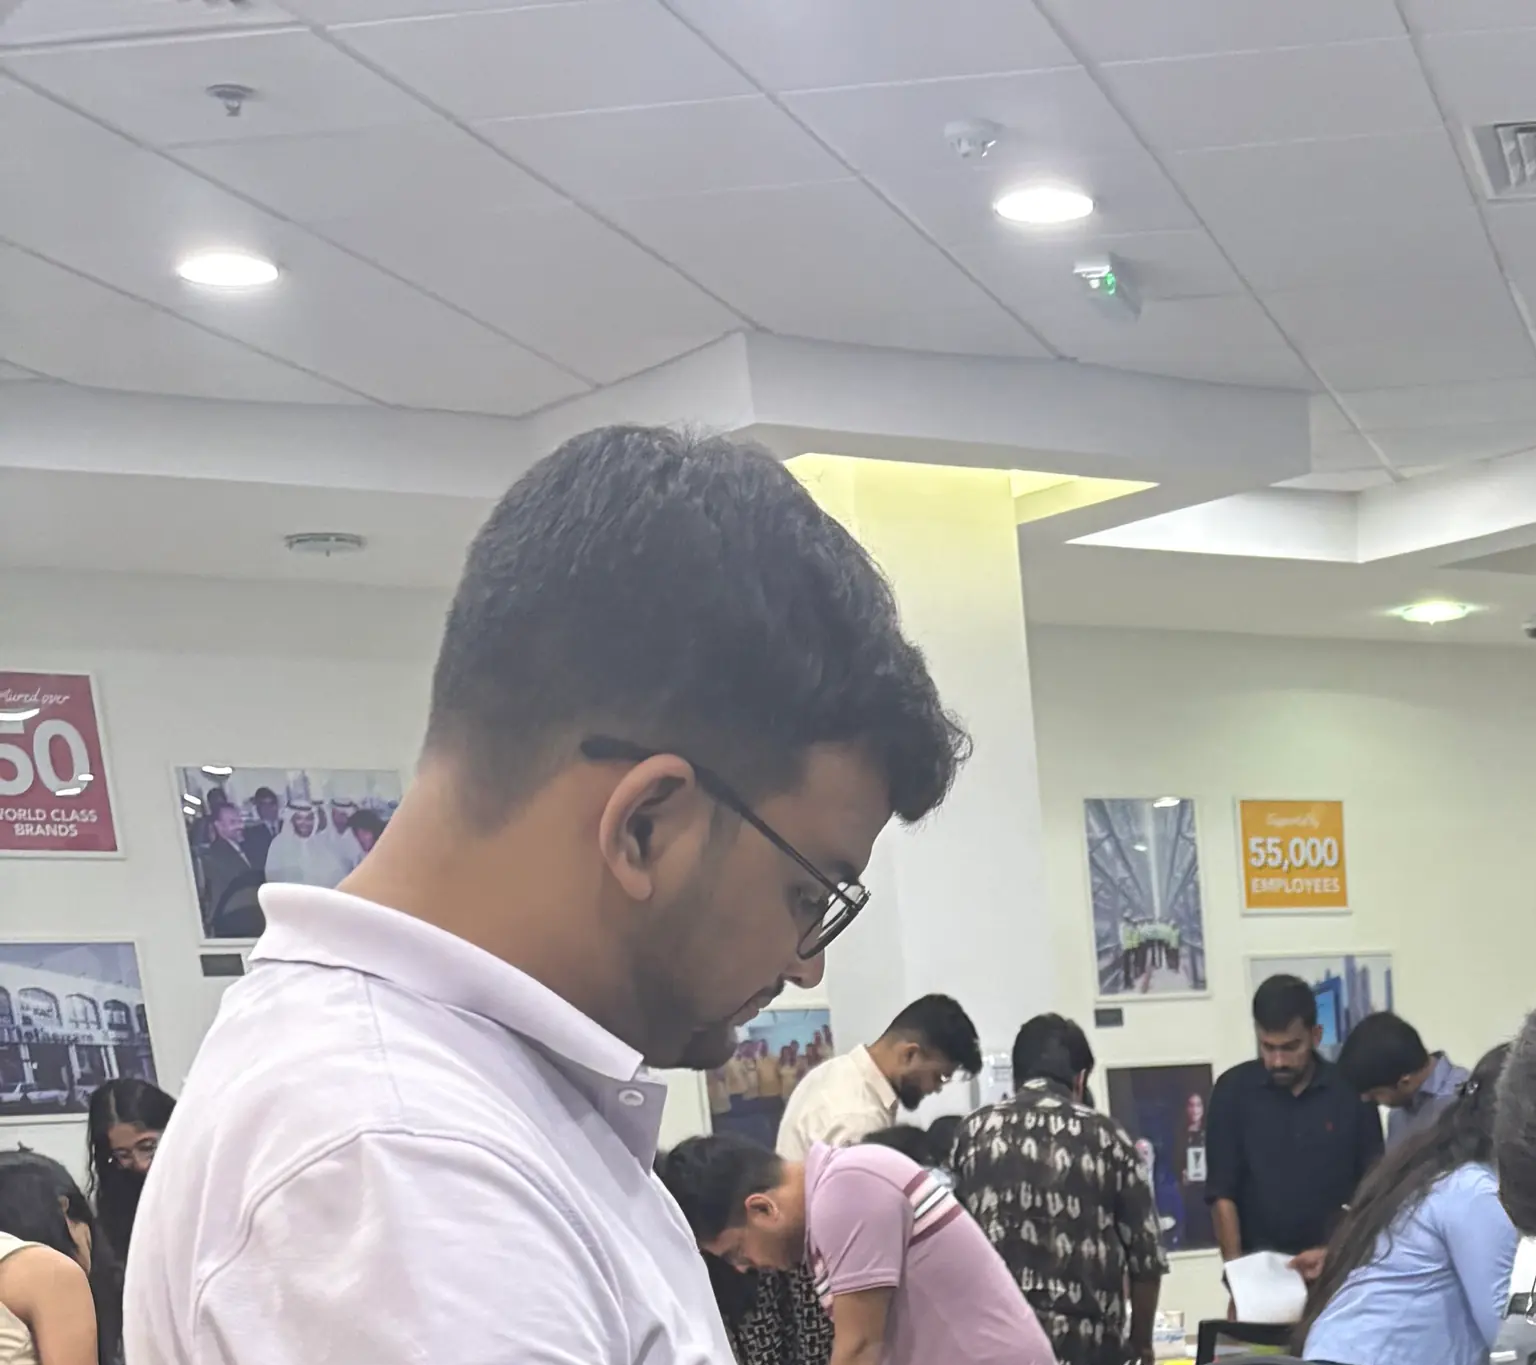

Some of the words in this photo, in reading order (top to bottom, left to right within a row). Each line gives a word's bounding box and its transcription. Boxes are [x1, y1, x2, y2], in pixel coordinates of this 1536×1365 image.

[0, 807, 47, 822] ORLD
[50, 808, 98, 823] CLASS
[14, 823, 78, 838] BRANDS
[1248, 836, 1339, 873] 55,000
[1251, 877, 1340, 894] EMPLOYEES
